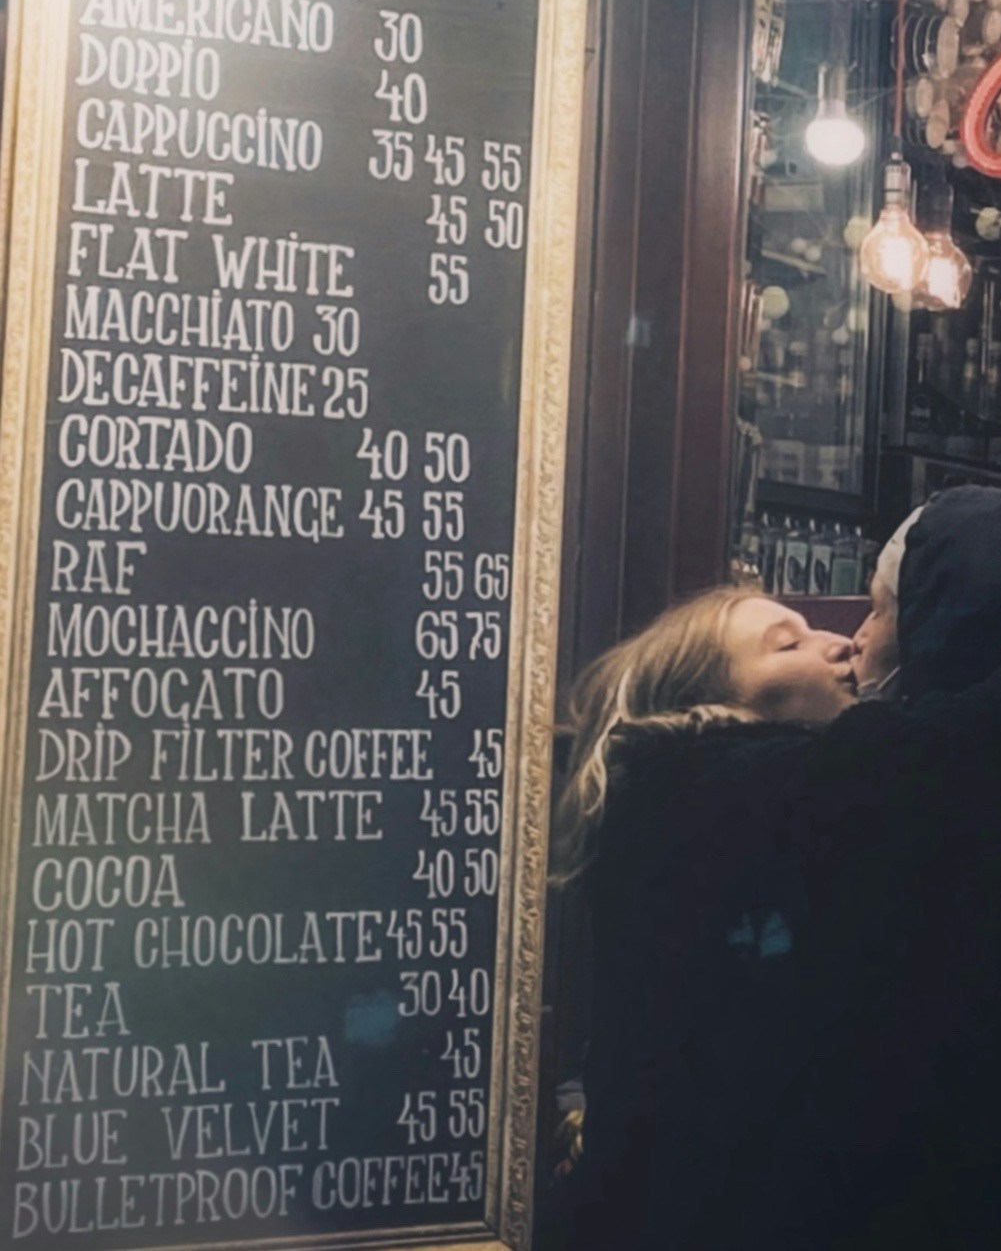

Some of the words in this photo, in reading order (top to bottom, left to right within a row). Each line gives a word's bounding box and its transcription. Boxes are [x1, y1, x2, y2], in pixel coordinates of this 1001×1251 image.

[374, 11, 424, 63] 30
[374, 70, 428, 124] 40
[369, 129, 413, 181] 35
[425, 134, 466, 186] 45
[482, 140, 522, 191] 55
[72, 158, 234, 225] LATTE
[426, 194, 467, 245] 45
[485, 201, 524, 249] 50
[67, 222, 188, 283] FLAT
[428, 253, 469, 305] 55
[313, 305, 360, 357] 30
[322, 366, 369, 419] 25
[58, 413, 253, 474] CORTADO
[357, 428, 408, 480] 40
[424, 432, 470, 483] 50
[55, 478, 344, 542] CAPPUORANGE
[360, 489, 404, 540] 45
[423, 491, 464, 541] 55
[50, 540, 147, 595] RAF
[423, 551, 463, 600] 55
[474, 553, 509, 601] 65
[415, 610, 458, 660] 65
[465, 612, 501, 660] 75
[37, 667, 284, 722] AFFOGATO
[416, 670, 461, 719] 45
[304, 729, 433, 780] COFFEE
[468, 729, 502, 779] 45
[32, 791, 211, 847] MATCHA
[240, 790, 383, 841] LATTE
[419, 789, 458, 837] 45
[465, 789, 499, 836] 55
[32, 854, 185, 912] COCOA
[413, 849, 454, 898] 40
[464, 849, 498, 897] 50
[25, 918, 115, 973] HOT
[134, 911, 382, 969] CHOCOLATE
[386, 909, 423, 960] 45
[430, 908, 468, 959] 55
[26, 982, 131, 1039] TEA
[399, 971, 441, 1017] 30
[448, 968, 490, 1018] 40
[18, 1042, 226, 1106] NATURAL
[252, 1036, 339, 1089] TEA
[440, 1029, 480, 1079] 45
[16, 1110, 127, 1171] BLUE
[161, 1098, 340, 1160] VELVET
[397, 1091, 437, 1144] 45
[449, 1089, 485, 1138] 55
[12, 1165, 303, 1239] BULLETPROOF
[311, 1154, 449, 1210] COFFEE
[449, 1150, 484, 1203] 45
